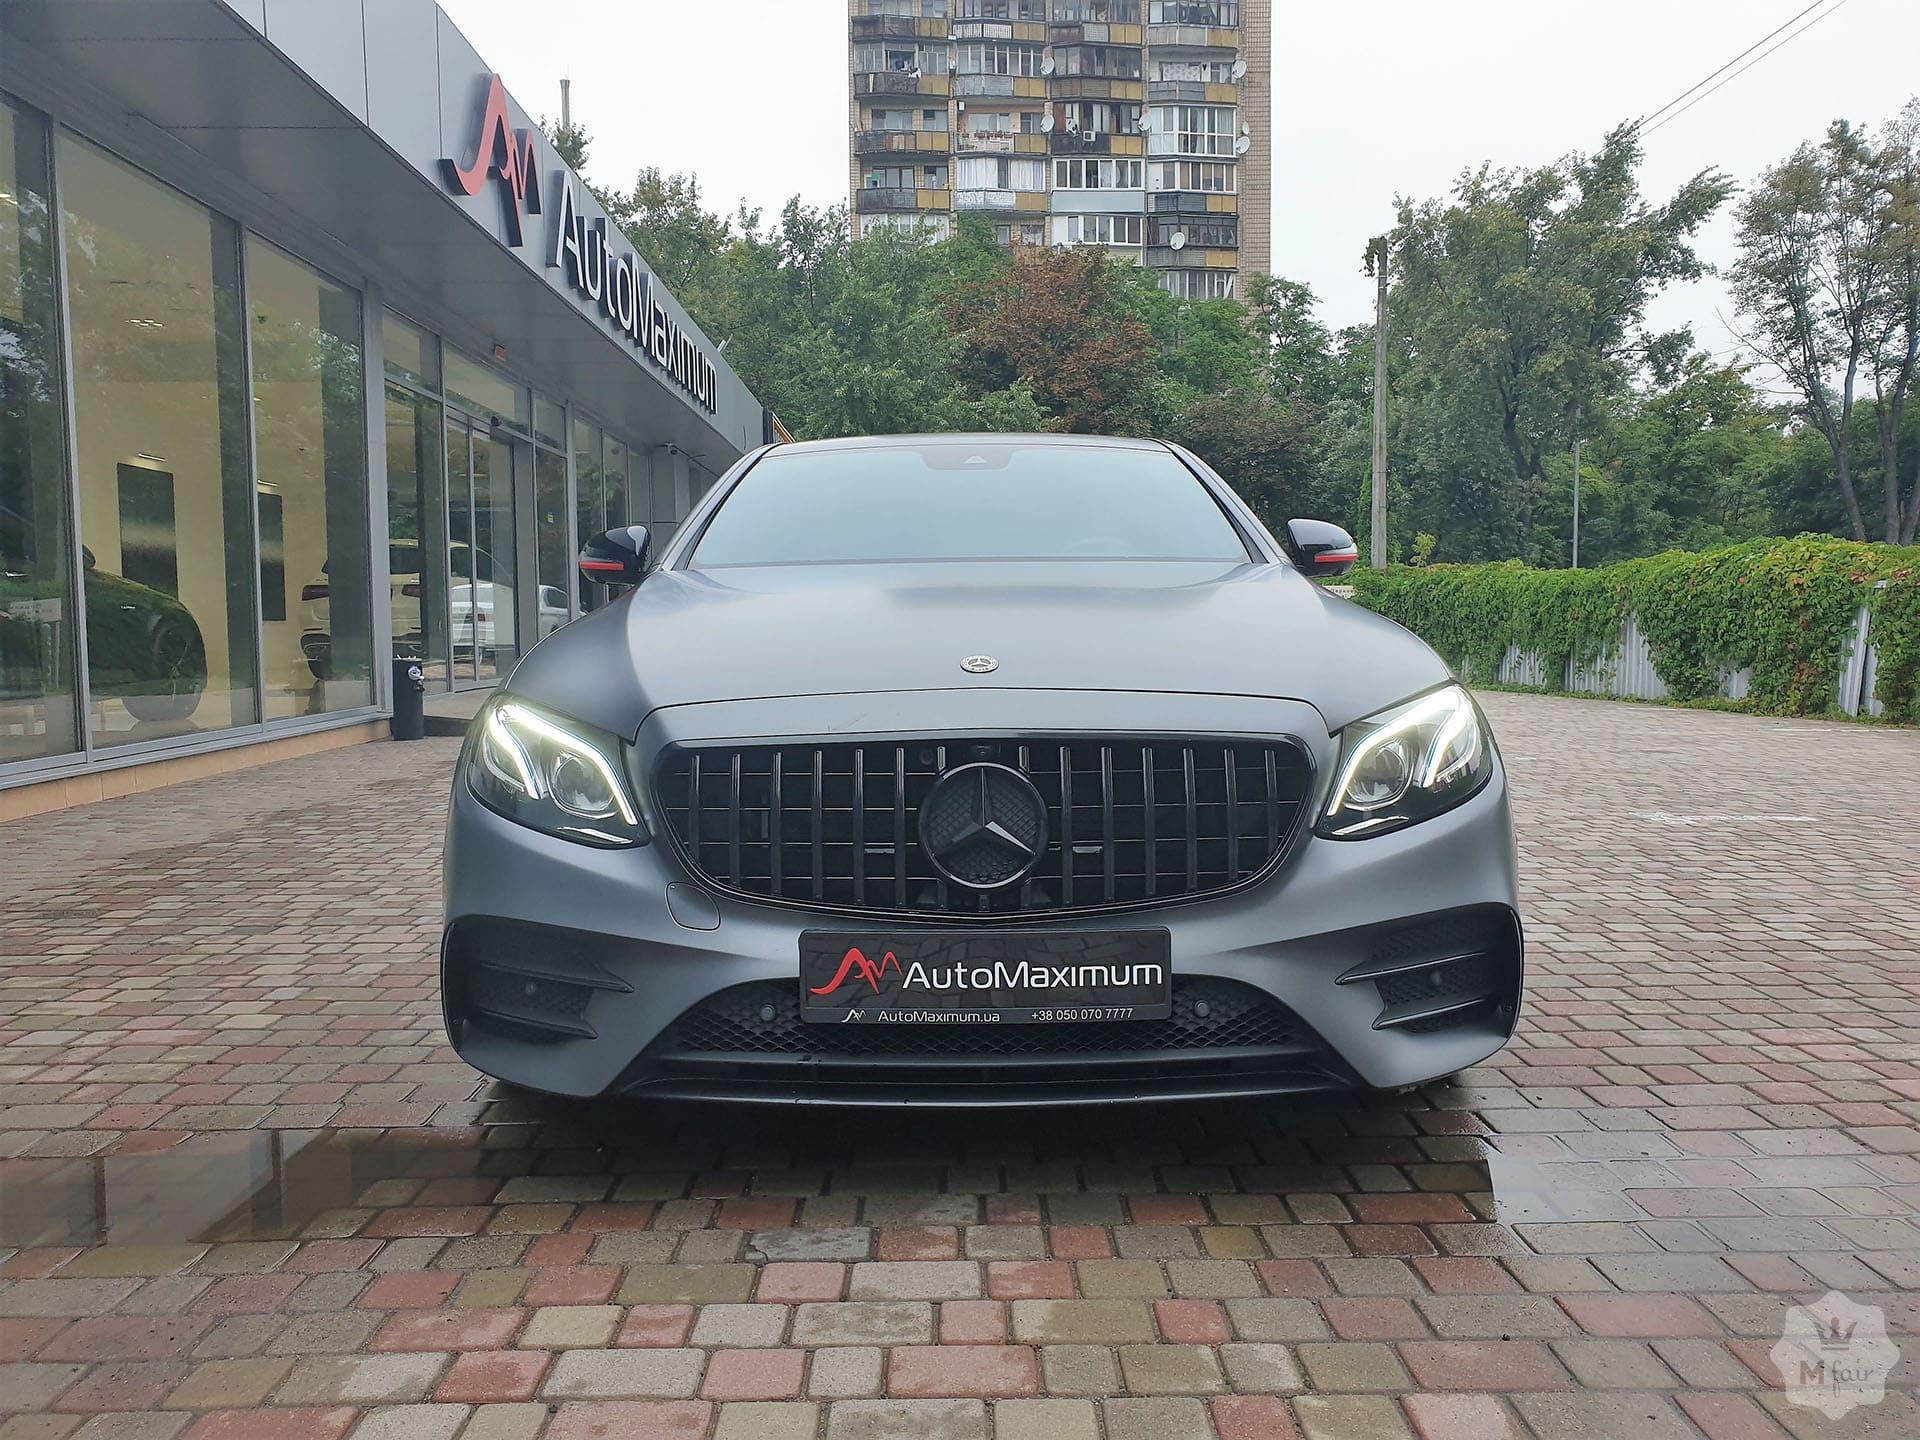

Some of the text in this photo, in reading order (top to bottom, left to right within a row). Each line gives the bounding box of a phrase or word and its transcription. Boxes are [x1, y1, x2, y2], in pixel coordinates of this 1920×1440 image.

[551, 170, 718, 415] AutoMaximum
[902, 960, 1163, 989] AutoMaximum
[878, 1010, 1000, 1023] AutoMaximum.ua
[1031, 1010, 1053, 1021] +38
[1056, 1009, 1078, 1021] 050
[1081, 1008, 1102, 1020] 070
[1105, 1008, 1133, 1019] 7777
